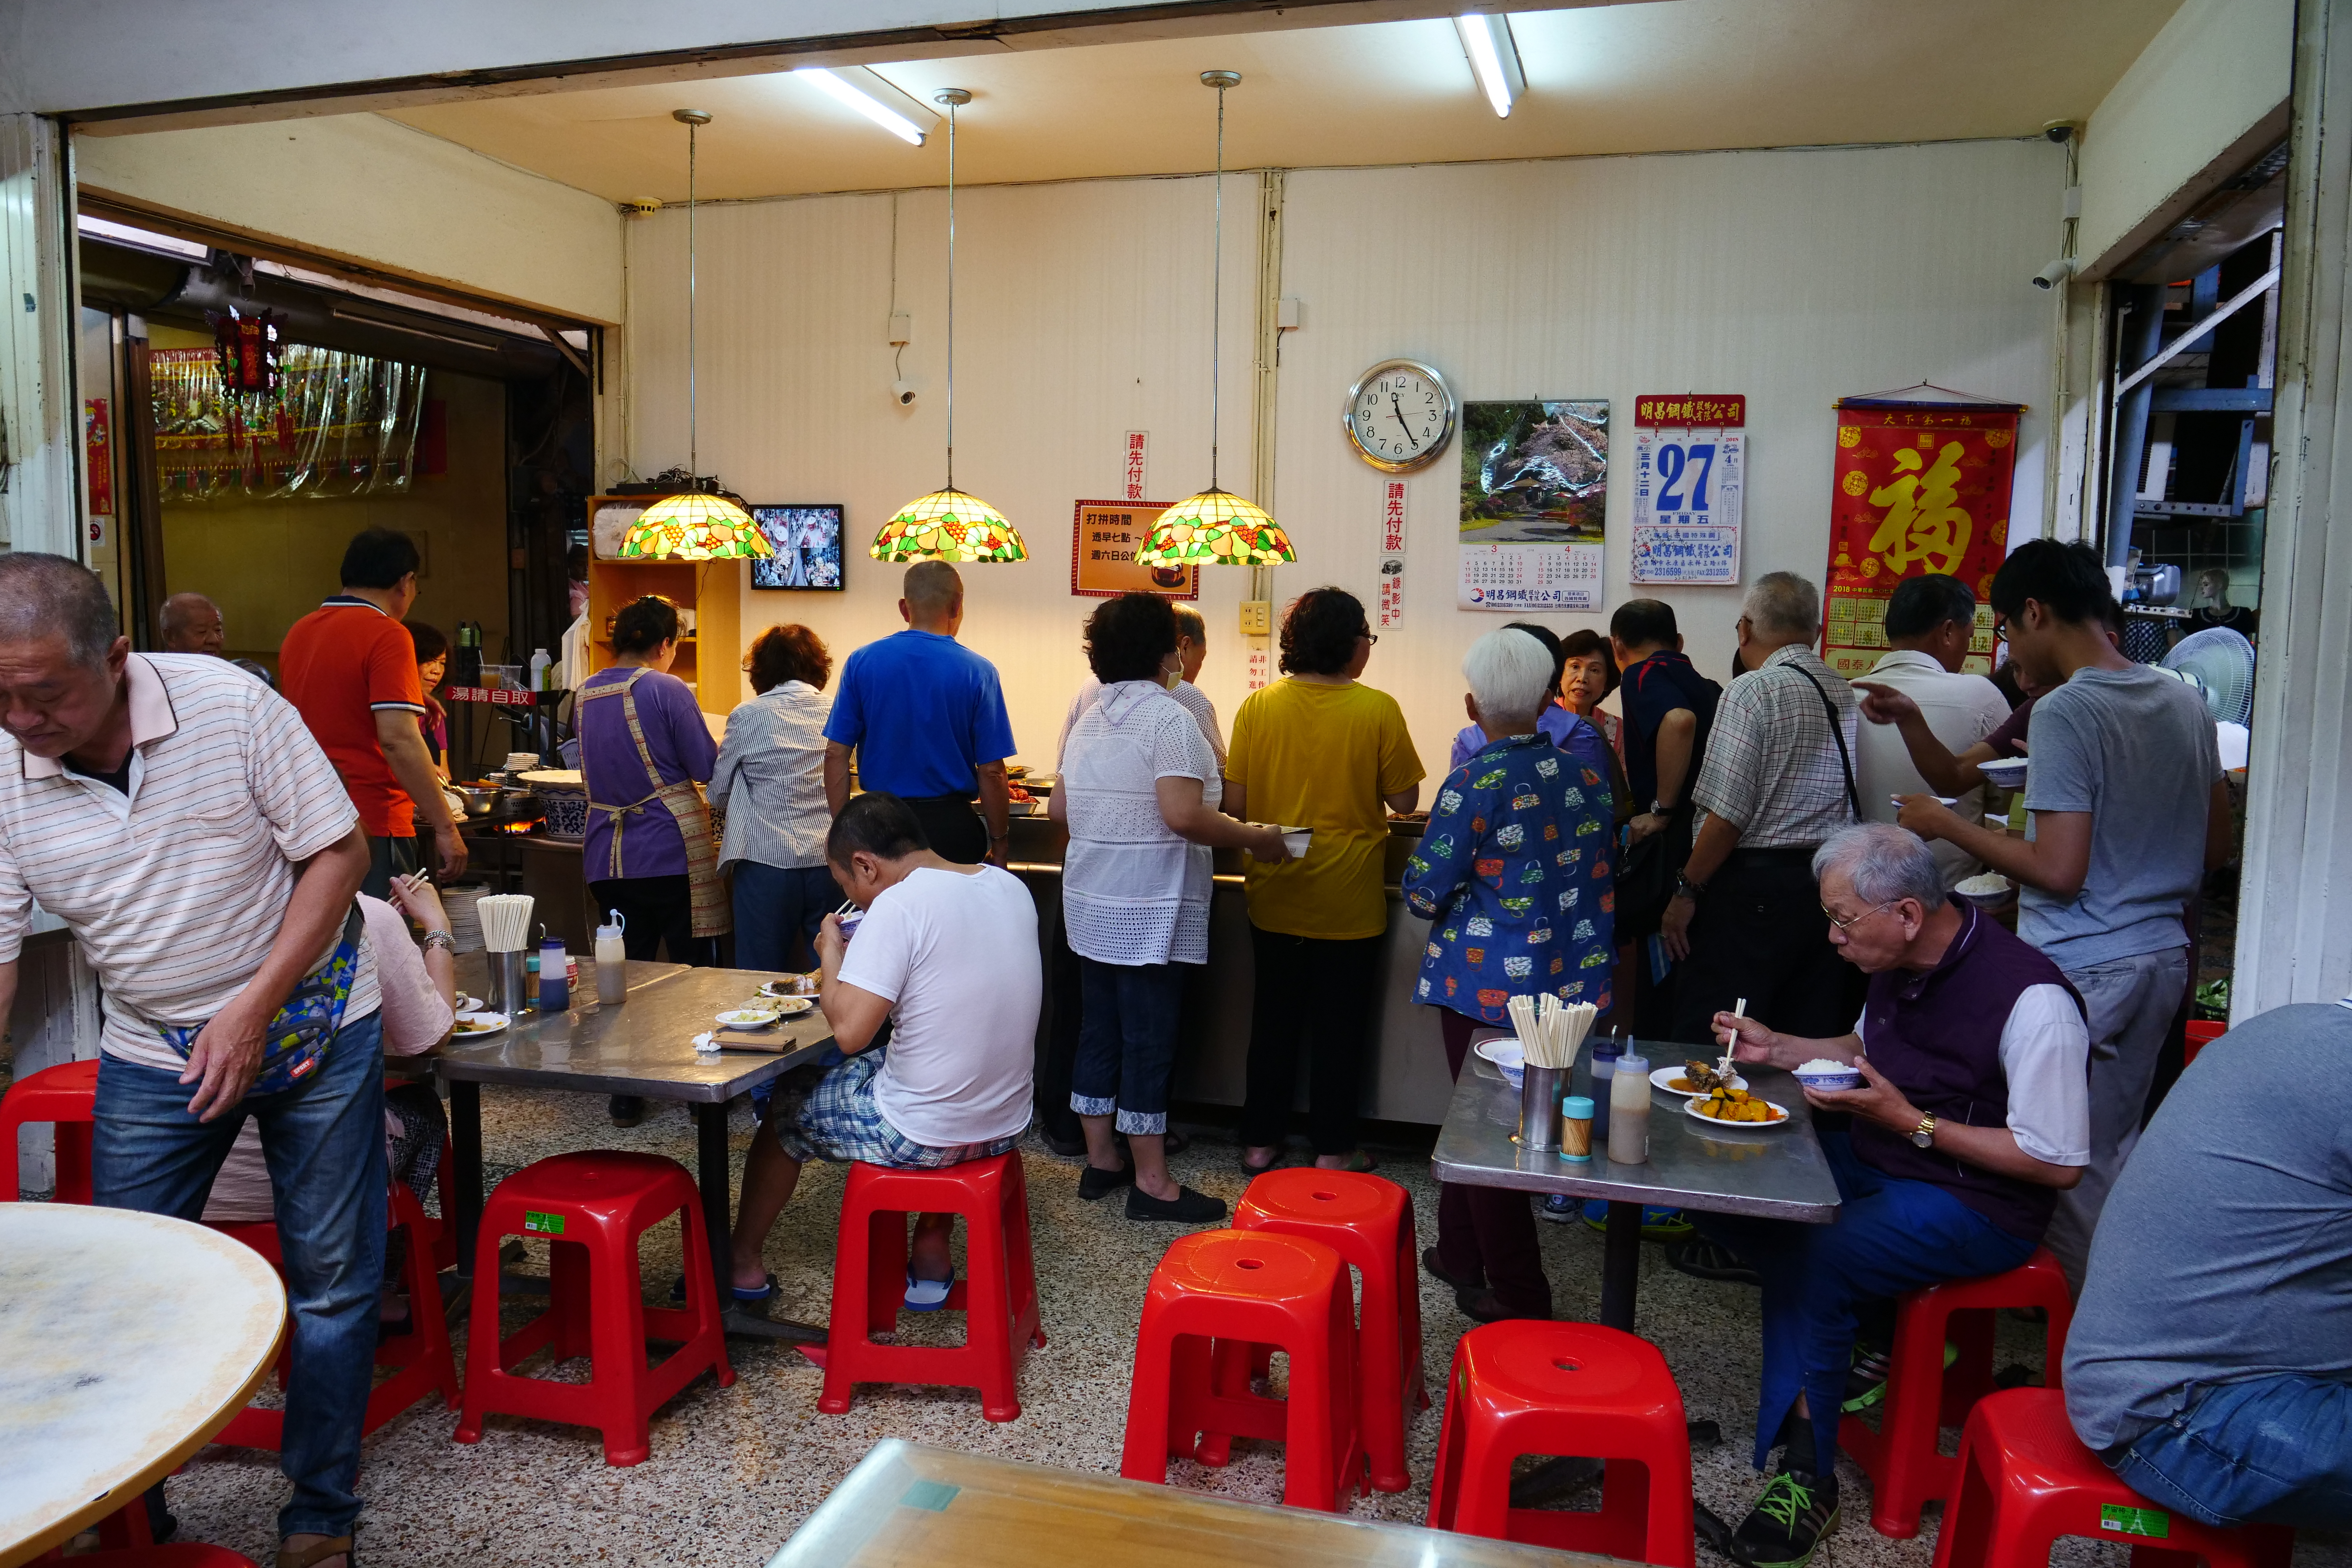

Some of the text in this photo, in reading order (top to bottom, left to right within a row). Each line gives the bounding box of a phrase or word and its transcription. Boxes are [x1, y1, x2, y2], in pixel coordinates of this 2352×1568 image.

[1381, 382, 1388, 392] 11
[1396, 377, 1406, 387] 12
[1368, 394, 1377, 405] 10
[1425, 392, 1433, 403] 2
[1363, 410, 1370, 421] 9
[1429, 410, 1436, 421] 3
[1641, 401, 1739, 421] 明昌鋼鐵股份有限公司
[1367, 426, 1375, 437] 8
[1423, 427, 1430, 438] 4
[1379, 439, 1386, 450] 7
[1394, 443, 1402, 454] 6
[1411, 439, 1418, 450] 5
[1127, 434, 1144, 499] 請先付款
[1640, 453, 1651, 496] 三月十二日
[1656, 444, 1715, 511] 27
[1868, 441, 1972, 576] 福
[1386, 483, 1404, 550] 請先付款
[1660, 515, 1709, 524] 星期五
[1392, 577, 1401, 620] 錄影中
[1381, 583, 1391, 626] 請微笑
[1249, 655, 1257, 689] 請勿進
[452, 687, 529, 705] 湯請自取
